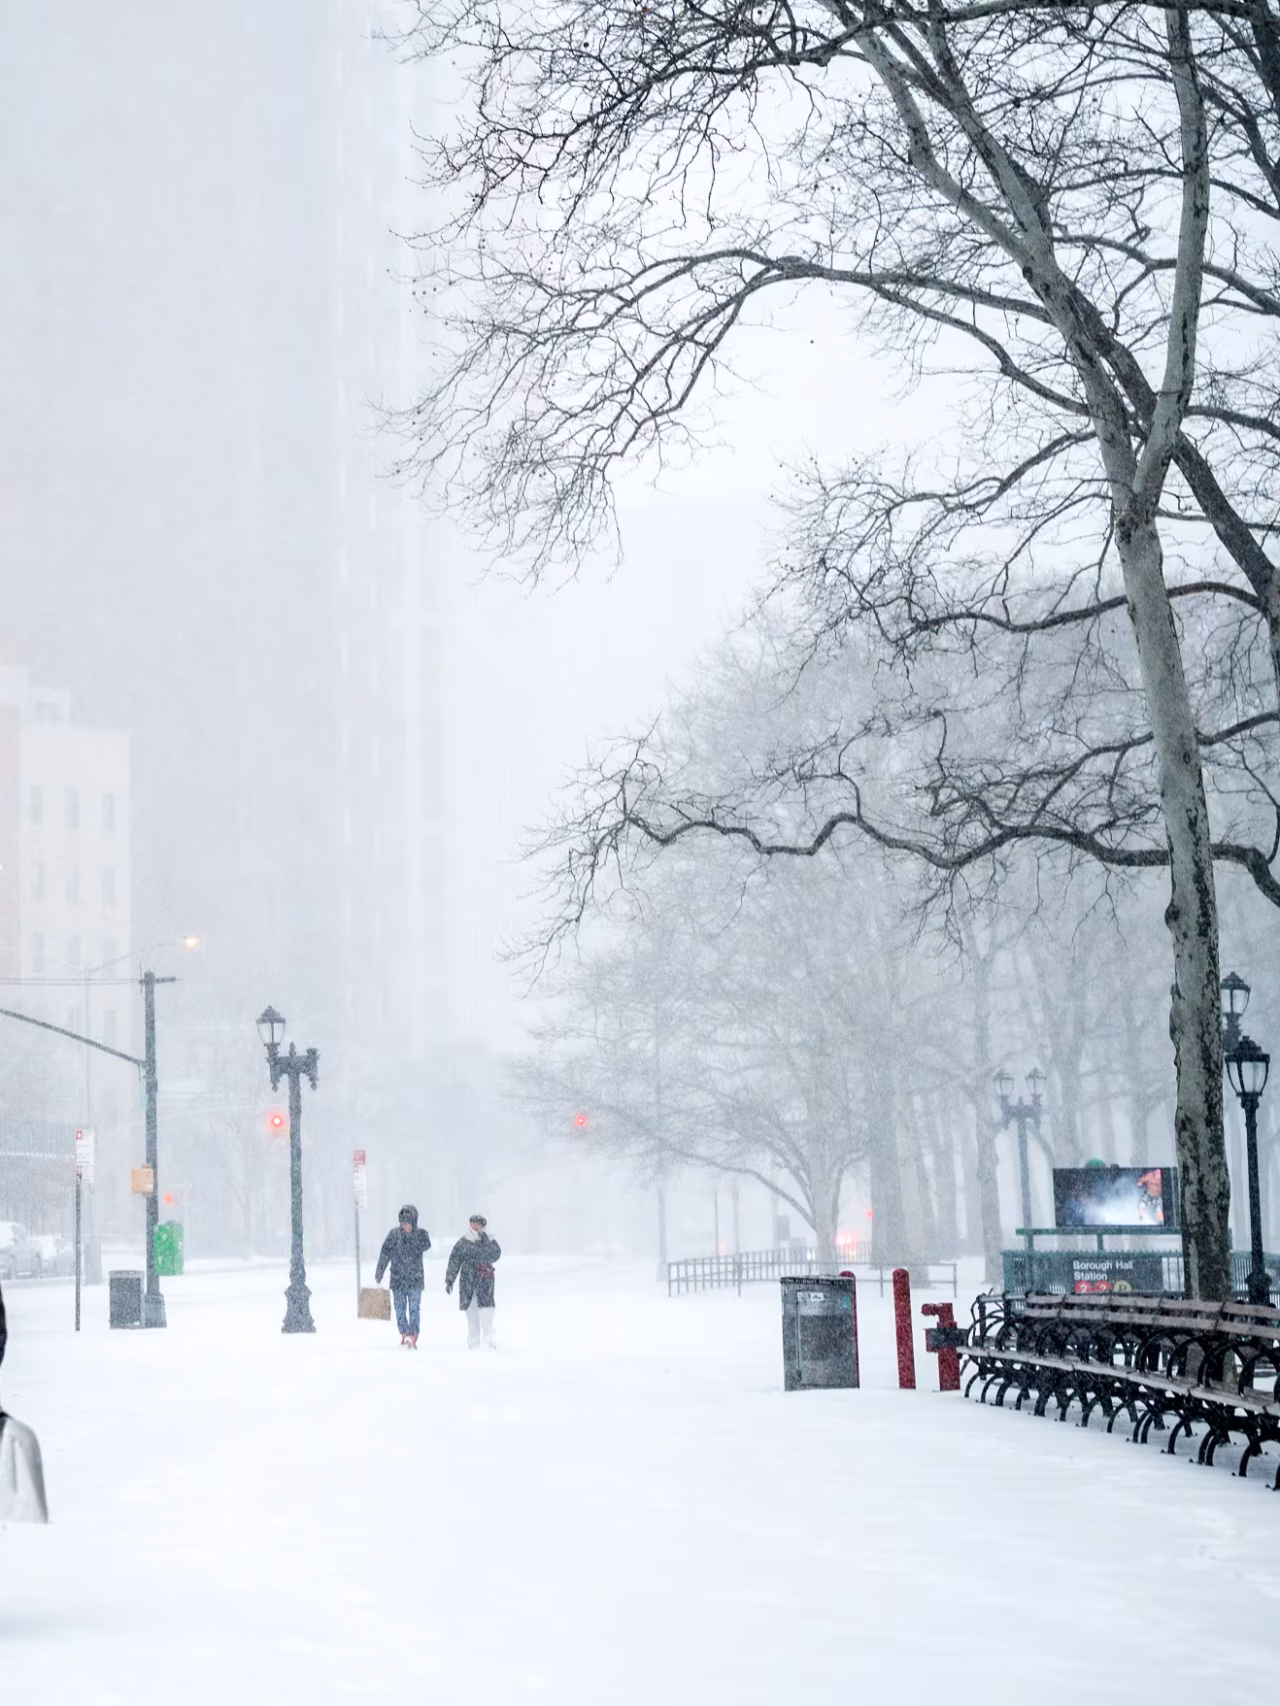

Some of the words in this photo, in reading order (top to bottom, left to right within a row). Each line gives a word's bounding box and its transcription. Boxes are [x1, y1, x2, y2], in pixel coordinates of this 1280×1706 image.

[1073, 1260, 1112, 1271] Borough
[1116, 1260, 1133, 1270] Hall
[1074, 1271, 1108, 1280] Station
